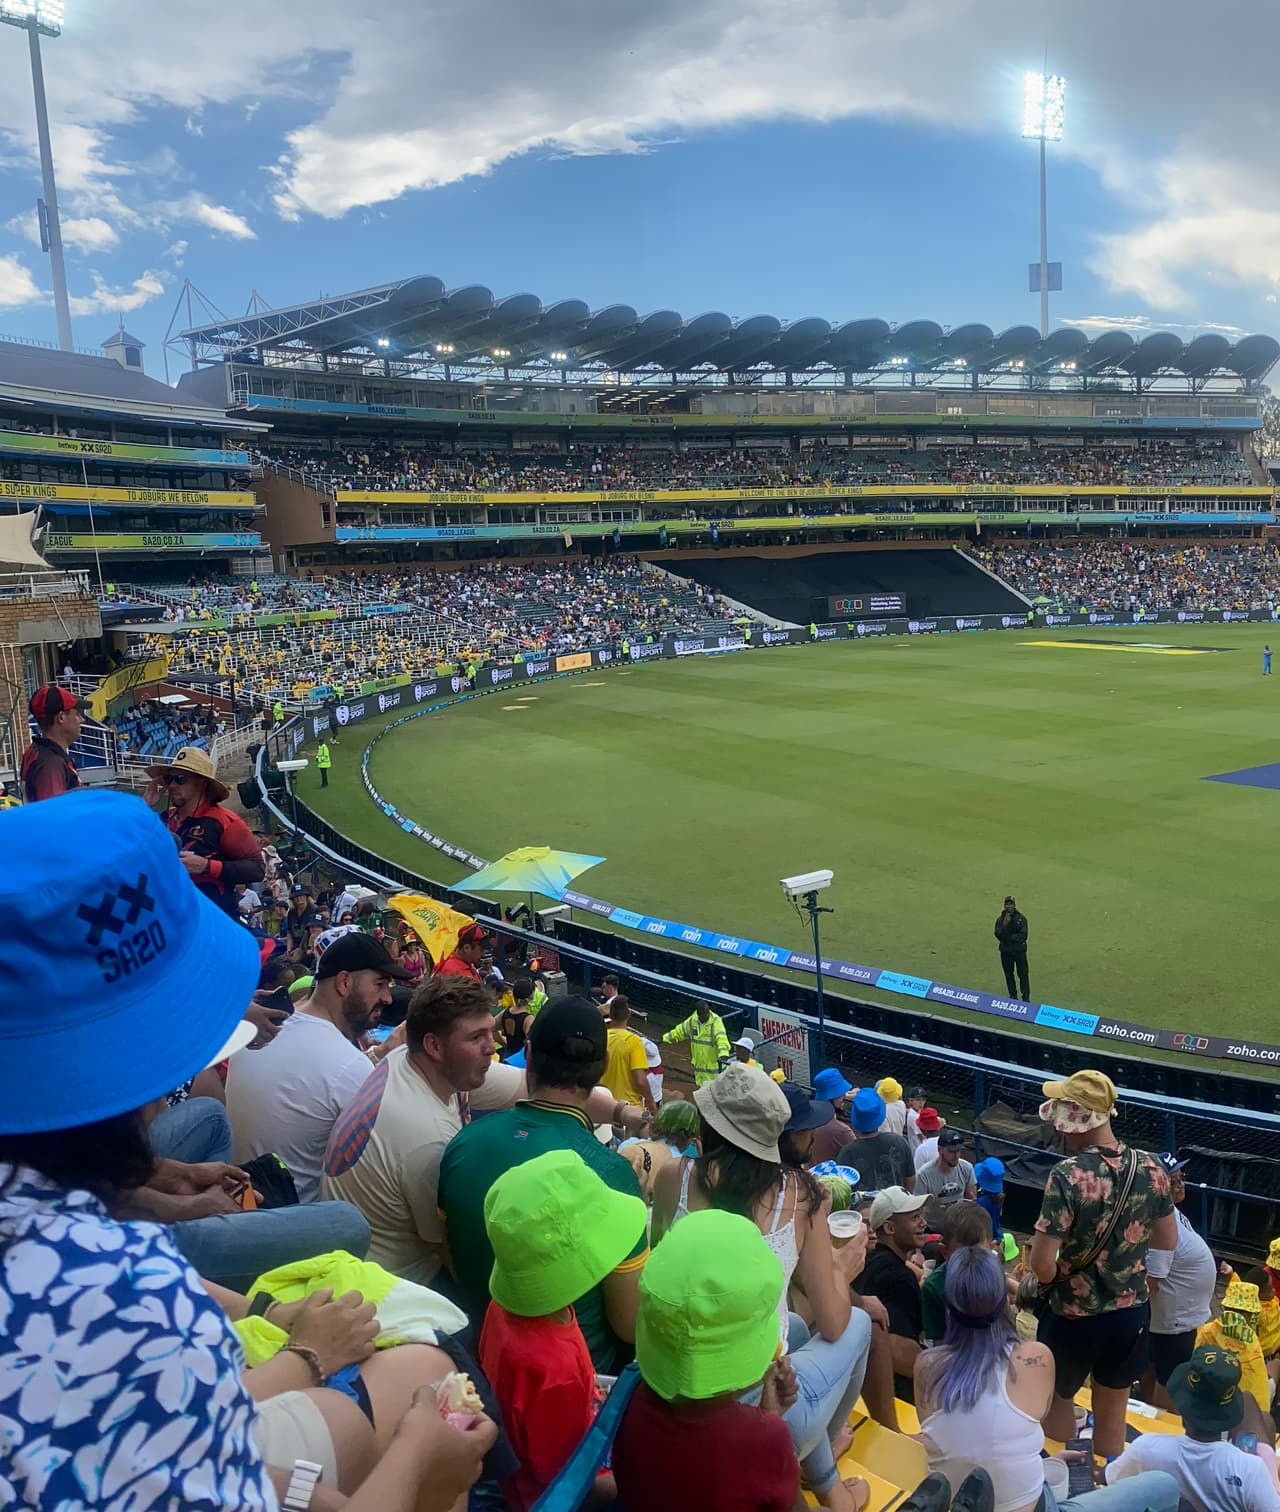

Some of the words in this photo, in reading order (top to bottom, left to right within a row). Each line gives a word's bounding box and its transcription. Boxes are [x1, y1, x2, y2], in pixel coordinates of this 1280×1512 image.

[58, 441, 78, 451] betway
[95, 444, 112, 454] SA20
[5, 484, 31, 496] SUPER
[33, 485, 57, 498] KINGS
[128, 491, 137, 501] TO
[138, 491, 166, 502] JOBURG
[168, 492, 180, 502] WE
[181, 492, 209, 504] BELONG
[142, 536, 184, 549] SA20.CO.ZA
[641, 648, 664, 658] SPORT
[646, 921, 668, 935] rain
[681, 929, 703, 942] rain
[717, 937, 740, 951] rain
[96, 920, 167, 983] SA20
[755, 948, 778, 963] rain
[839, 964, 871, 980] SA20.CO.ZA
[932, 986, 980, 1004] @SA20_LEAGUE
[991, 1000, 1028, 1015] SA20.CO.ZA
[1040, 1009, 1061, 1022] betway
[1076, 1017, 1095, 1029] SA20
[761, 1017, 805, 1052] EMERGENCY
[1099, 1024, 1156, 1043] zoho.com
